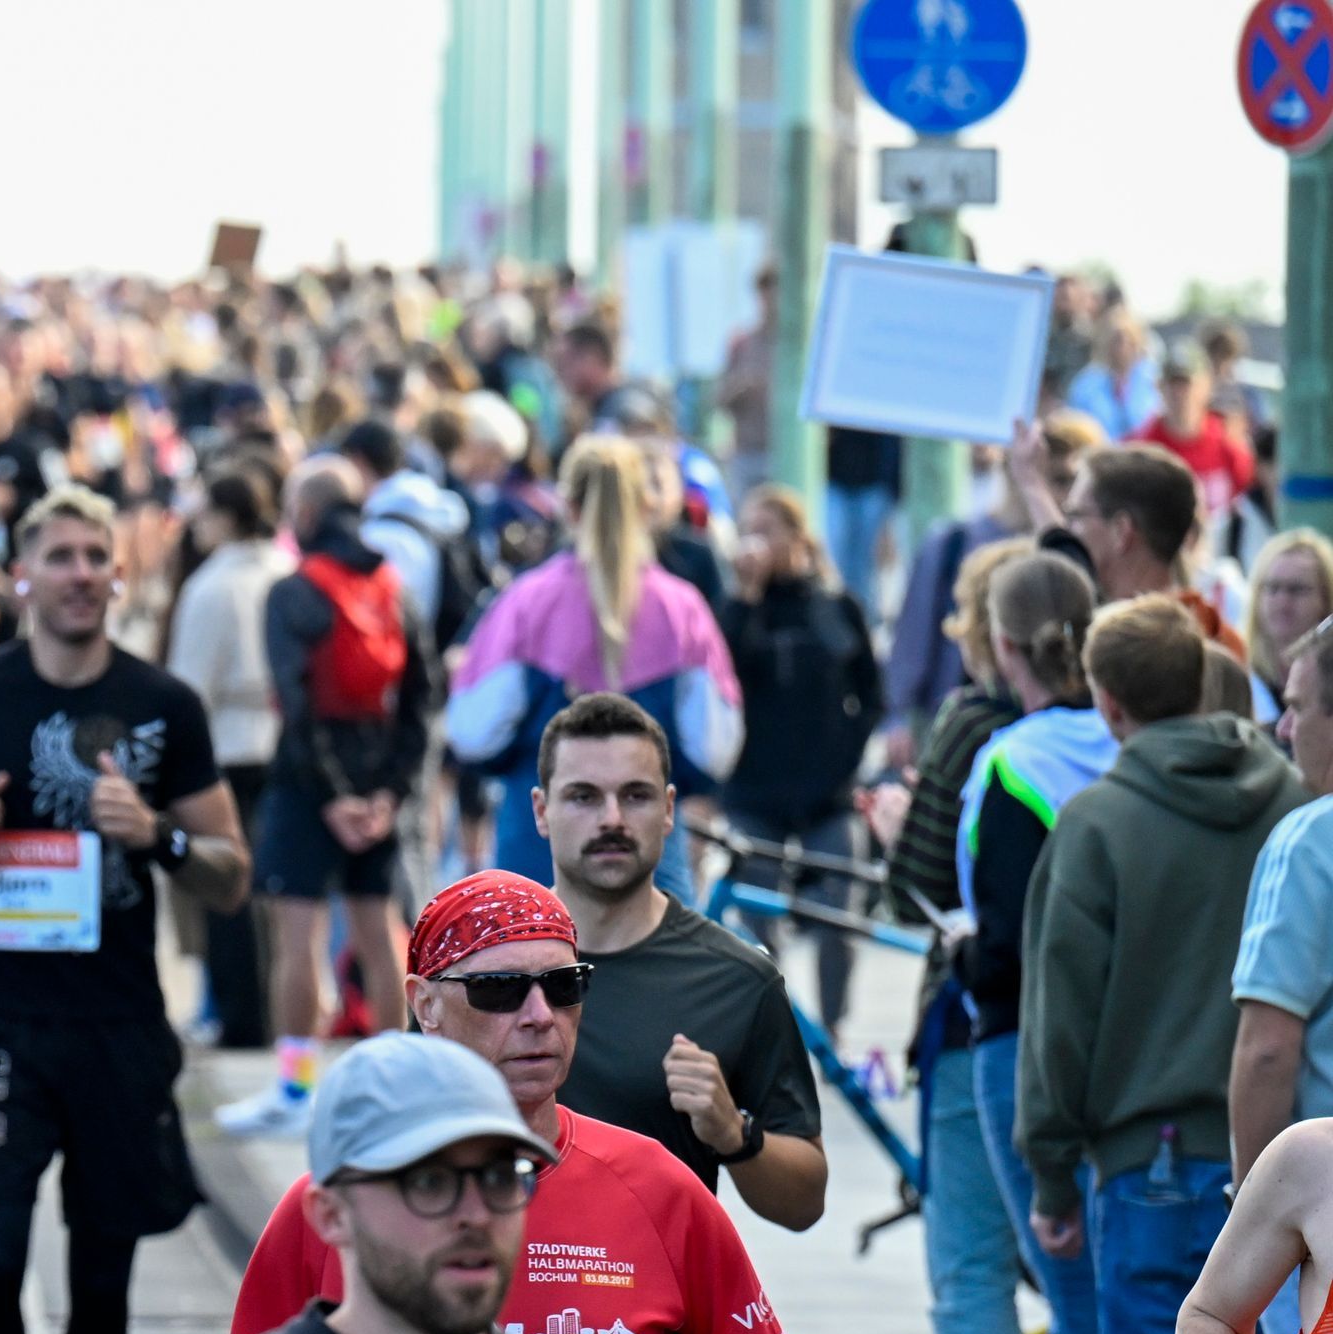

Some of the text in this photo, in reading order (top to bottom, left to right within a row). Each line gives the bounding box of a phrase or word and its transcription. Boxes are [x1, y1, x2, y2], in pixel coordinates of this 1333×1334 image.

[527, 1243, 607, 1258] STADTWERKE
[528, 1258, 634, 1274] HALBMARATHON
[529, 1272, 631, 1285] BOCHUM 03.09.2017
